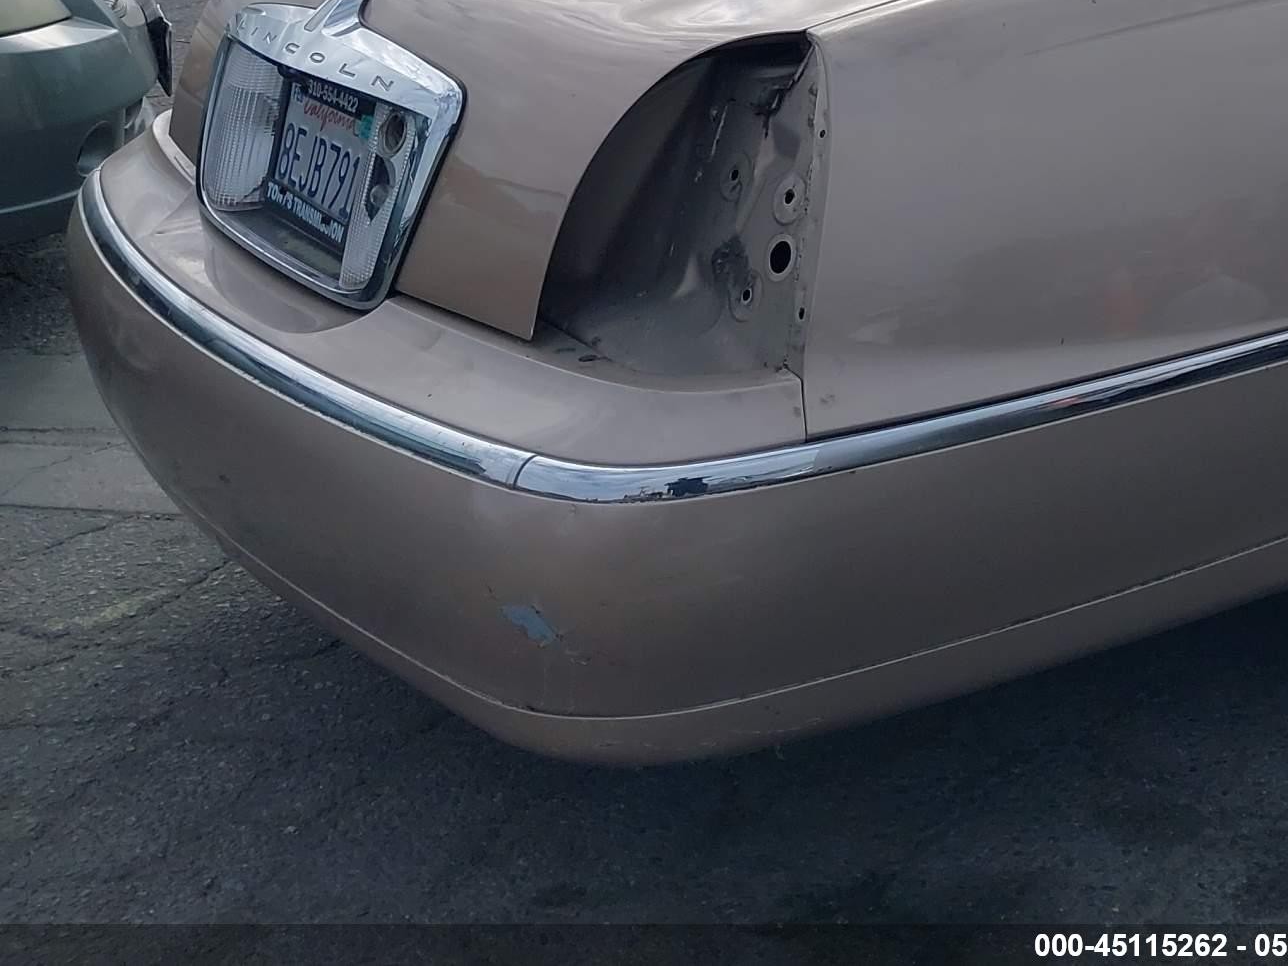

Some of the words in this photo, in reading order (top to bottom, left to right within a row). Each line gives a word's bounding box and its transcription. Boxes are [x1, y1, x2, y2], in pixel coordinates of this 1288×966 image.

[237, 18, 395, 92] LINCOLN
[308, 79, 359, 113] 310-554-4422
[277, 122, 360, 221] 8EJB791
